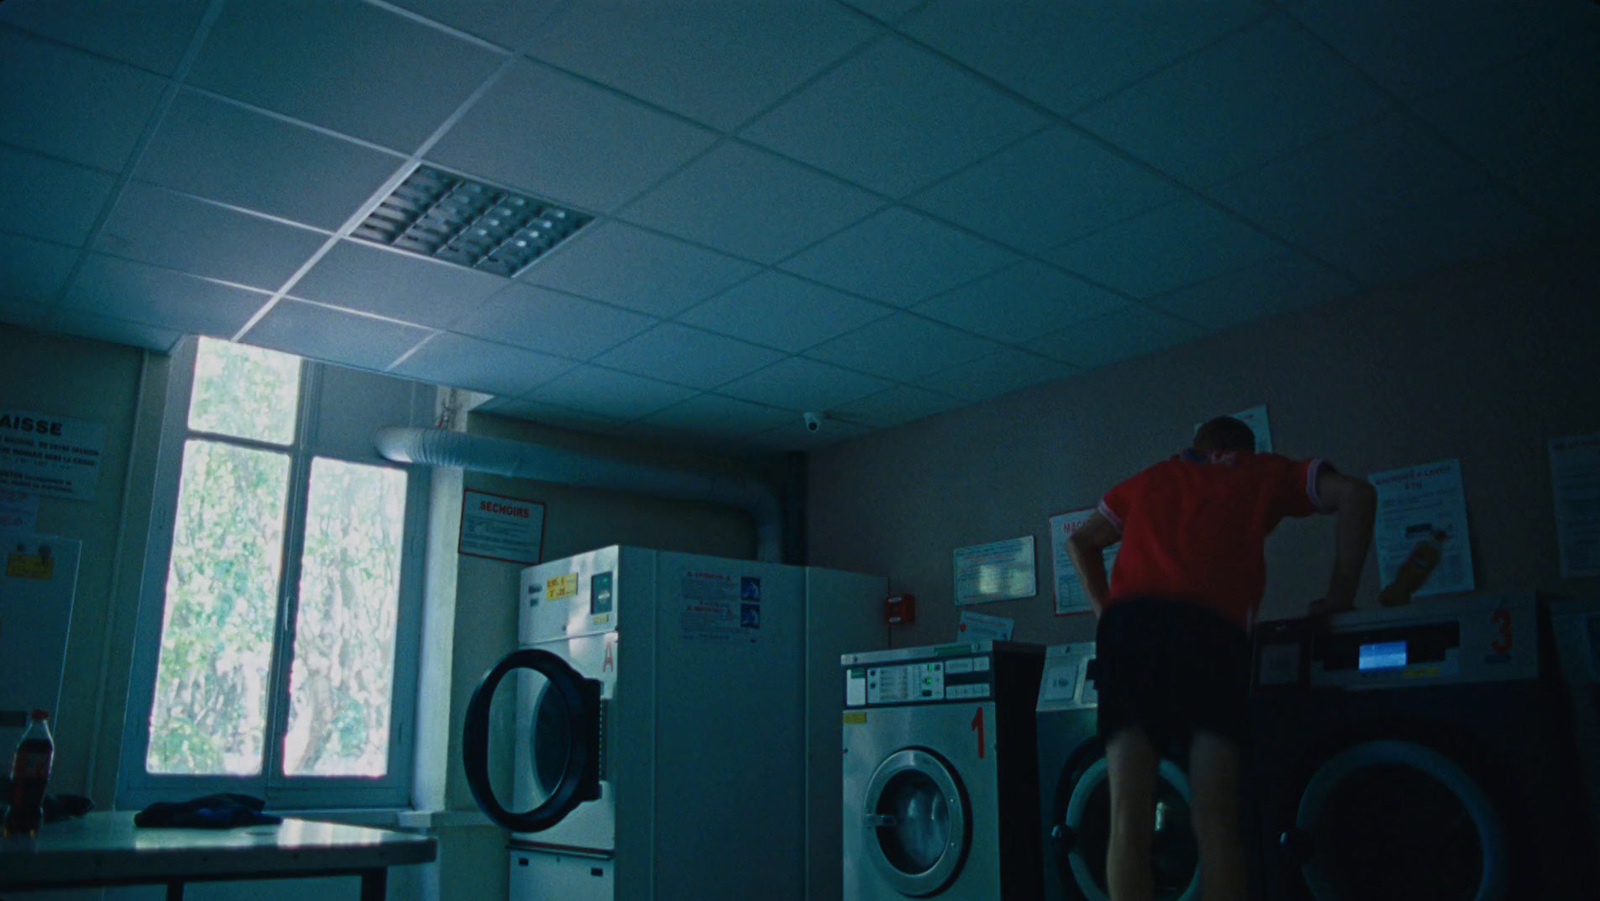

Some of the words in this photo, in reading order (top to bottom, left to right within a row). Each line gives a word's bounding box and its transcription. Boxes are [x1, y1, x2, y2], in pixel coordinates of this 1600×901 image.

[1490, 608, 1513, 654] 3
[602, 641, 614, 673] A
[971, 706, 984, 759] 1
